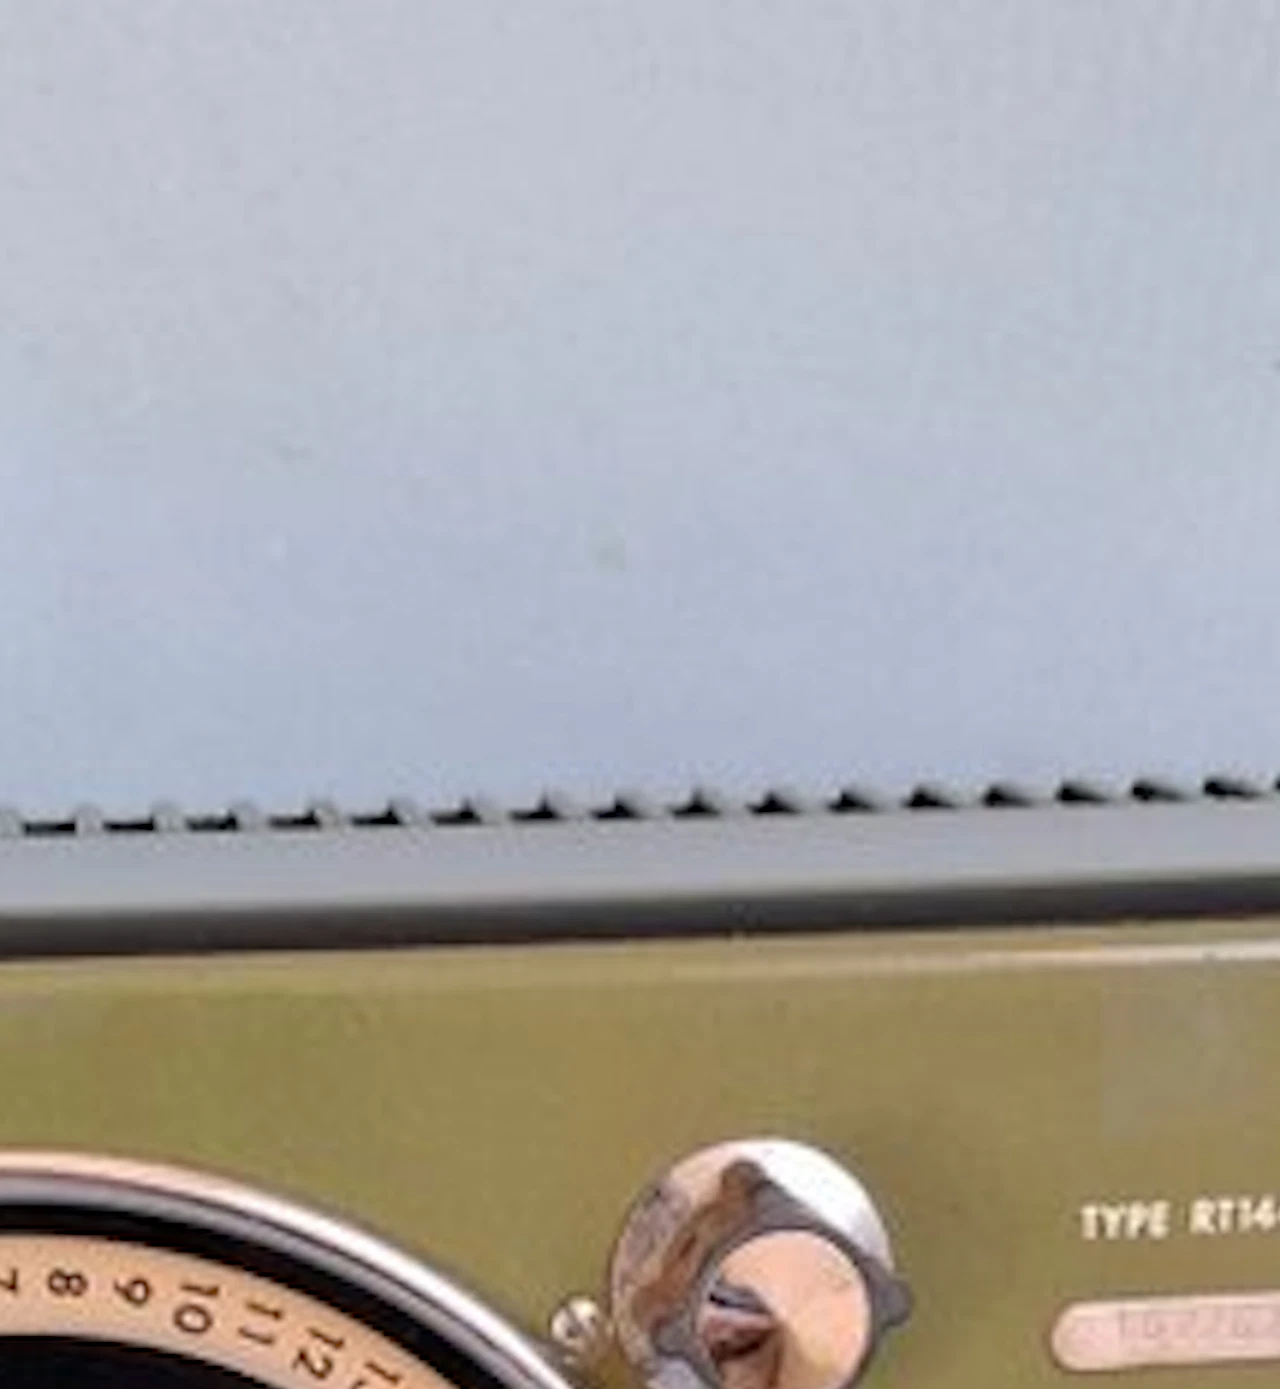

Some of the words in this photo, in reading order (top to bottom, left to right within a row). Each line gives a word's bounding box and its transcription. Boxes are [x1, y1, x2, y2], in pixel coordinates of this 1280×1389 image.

[1081, 1202, 1170, 1240] TYPE
[47, 1268, 88, 1296] 8
[114, 1277, 152, 1307] 9
[173, 1283, 219, 1334] 10
[237, 1302, 282, 1348] 11
[292, 1330, 345, 1381] 12
